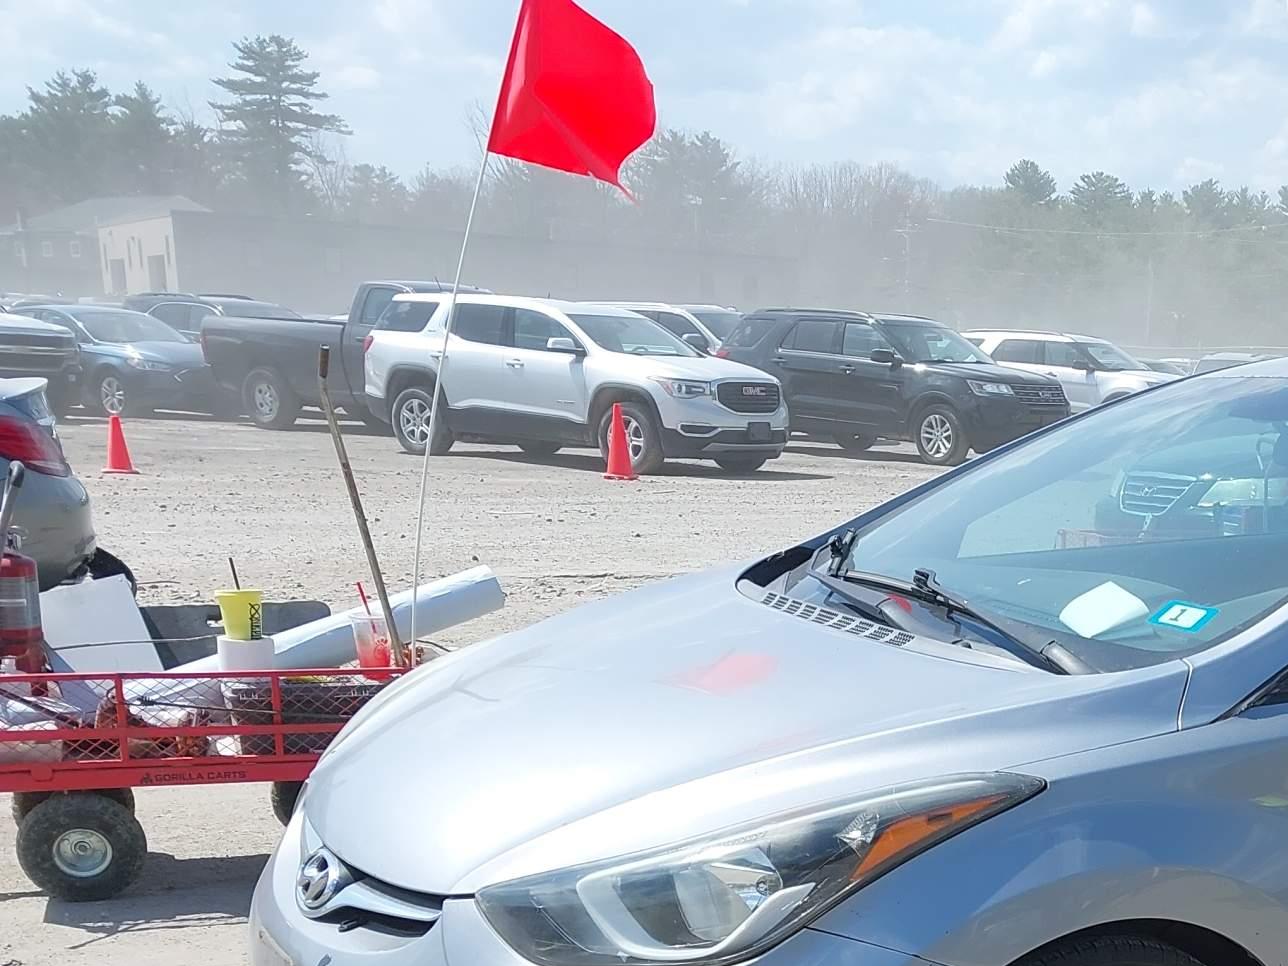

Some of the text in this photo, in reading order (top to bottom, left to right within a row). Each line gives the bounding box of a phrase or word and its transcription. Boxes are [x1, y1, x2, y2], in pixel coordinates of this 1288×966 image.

[742, 386, 767, 396] GMC
[1169, 608, 1188, 622] 1
[154, 770, 247, 783] GORILLA CARTS
